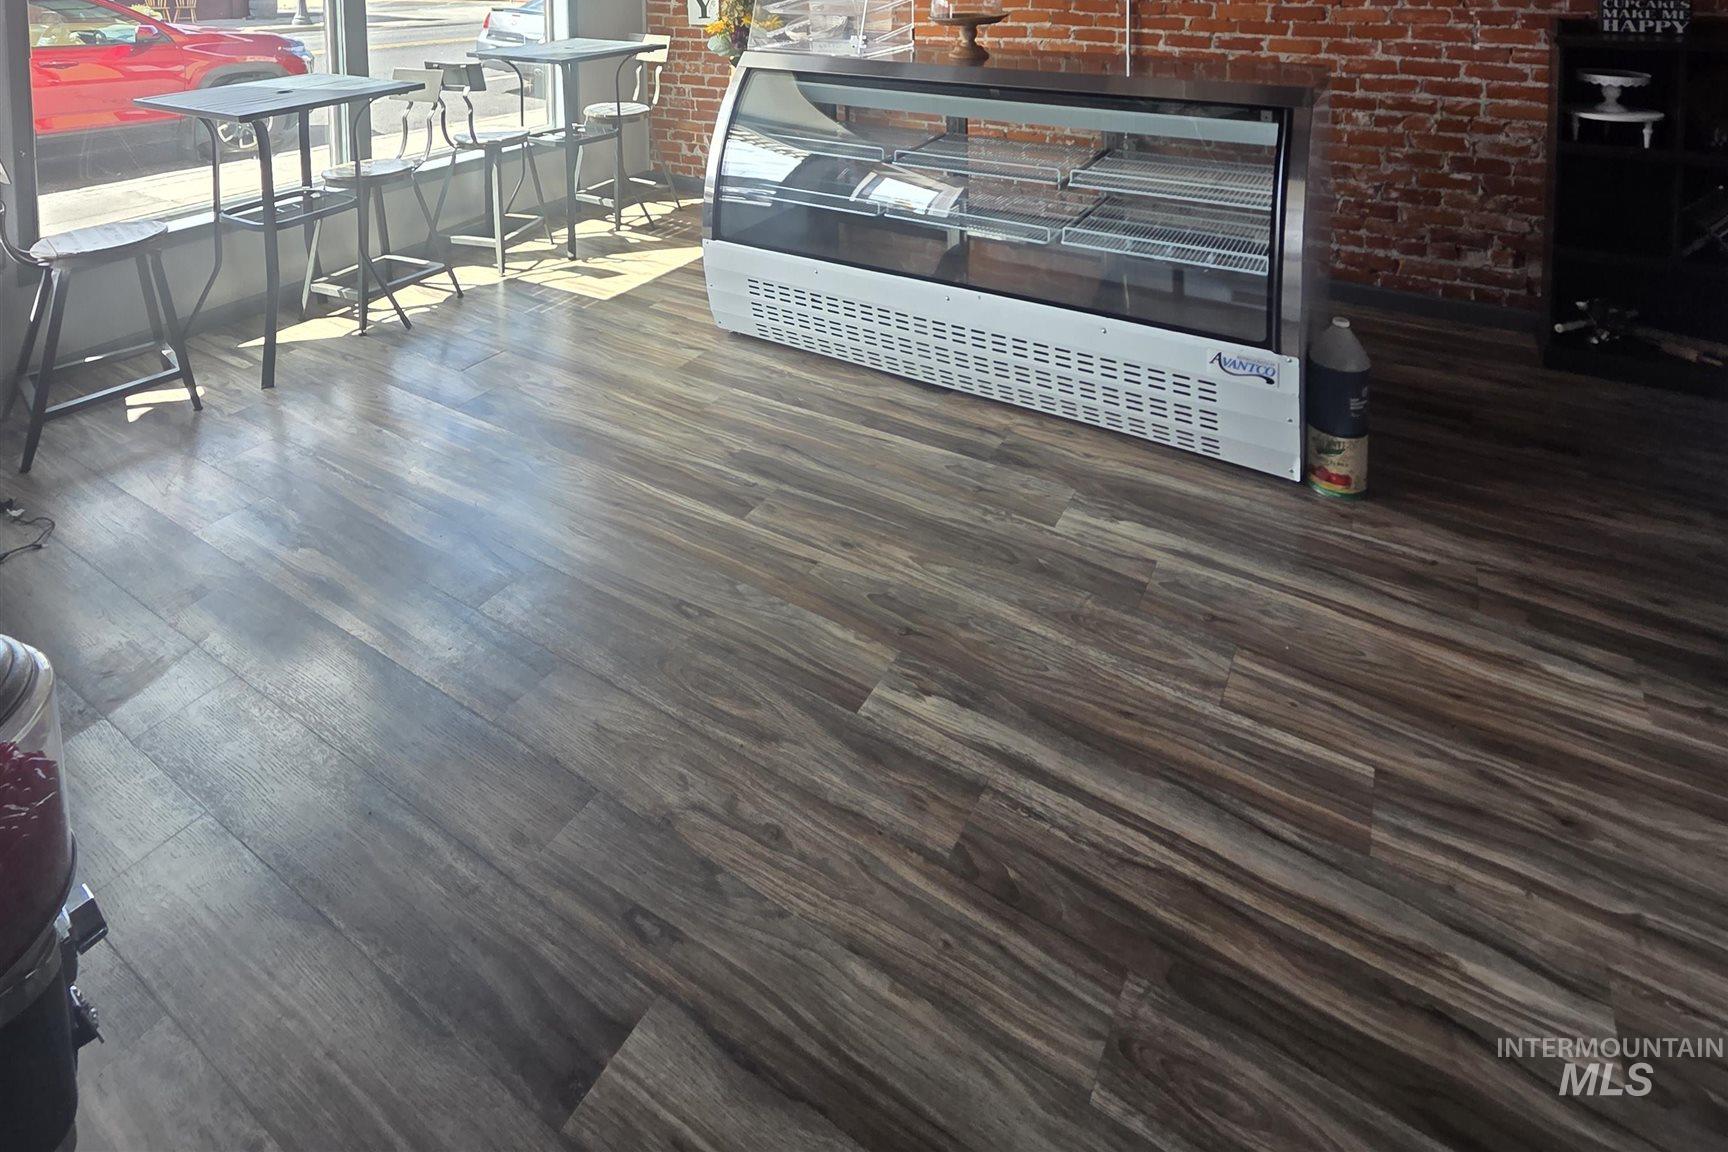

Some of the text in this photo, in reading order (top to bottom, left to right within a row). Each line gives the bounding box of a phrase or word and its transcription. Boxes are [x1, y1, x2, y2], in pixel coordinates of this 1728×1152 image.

[1602, 0, 1691, 9] CUPCAKES
[1602, 9, 1656, 19] MAKE
[1602, 19, 1690, 34] HAPPY
[1209, 351, 1276, 380] AVANTCO
